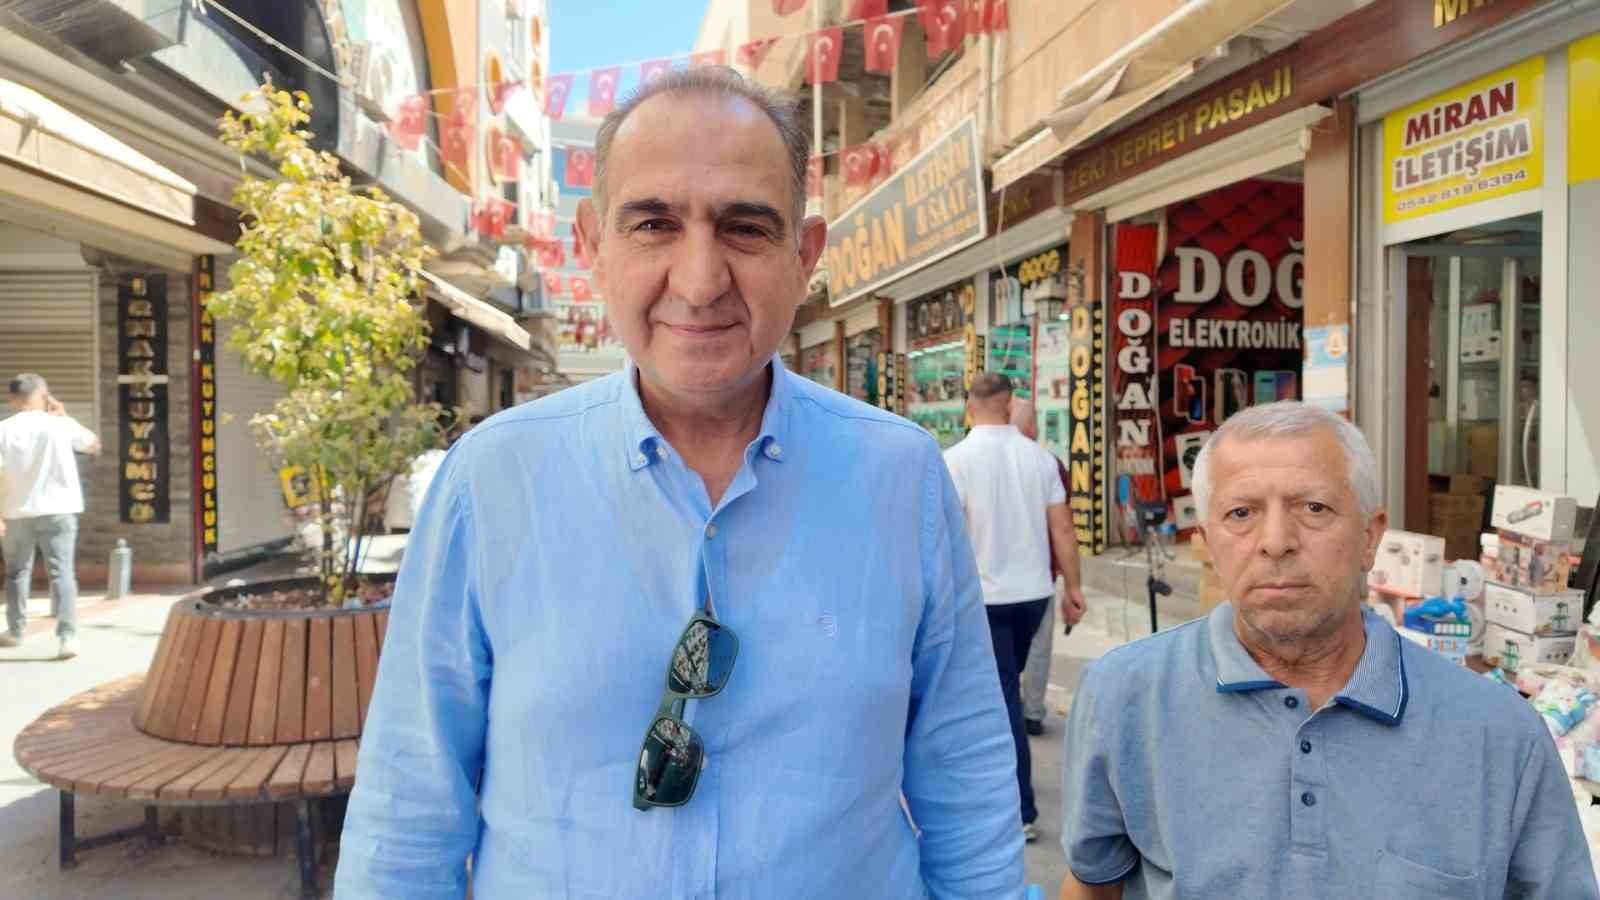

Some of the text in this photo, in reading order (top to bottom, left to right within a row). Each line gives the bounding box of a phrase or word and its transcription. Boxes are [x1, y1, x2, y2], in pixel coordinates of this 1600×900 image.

[1405, 81, 1515, 146] MİRAN
[1395, 122, 1529, 188] İLETİŞİM
[829, 202, 907, 295] DOĞAN
[1117, 271, 1152, 447] DOĞAN
[1168, 316, 1301, 350] ELEKTRONİK
[1071, 306, 1091, 493] DOĞAN
